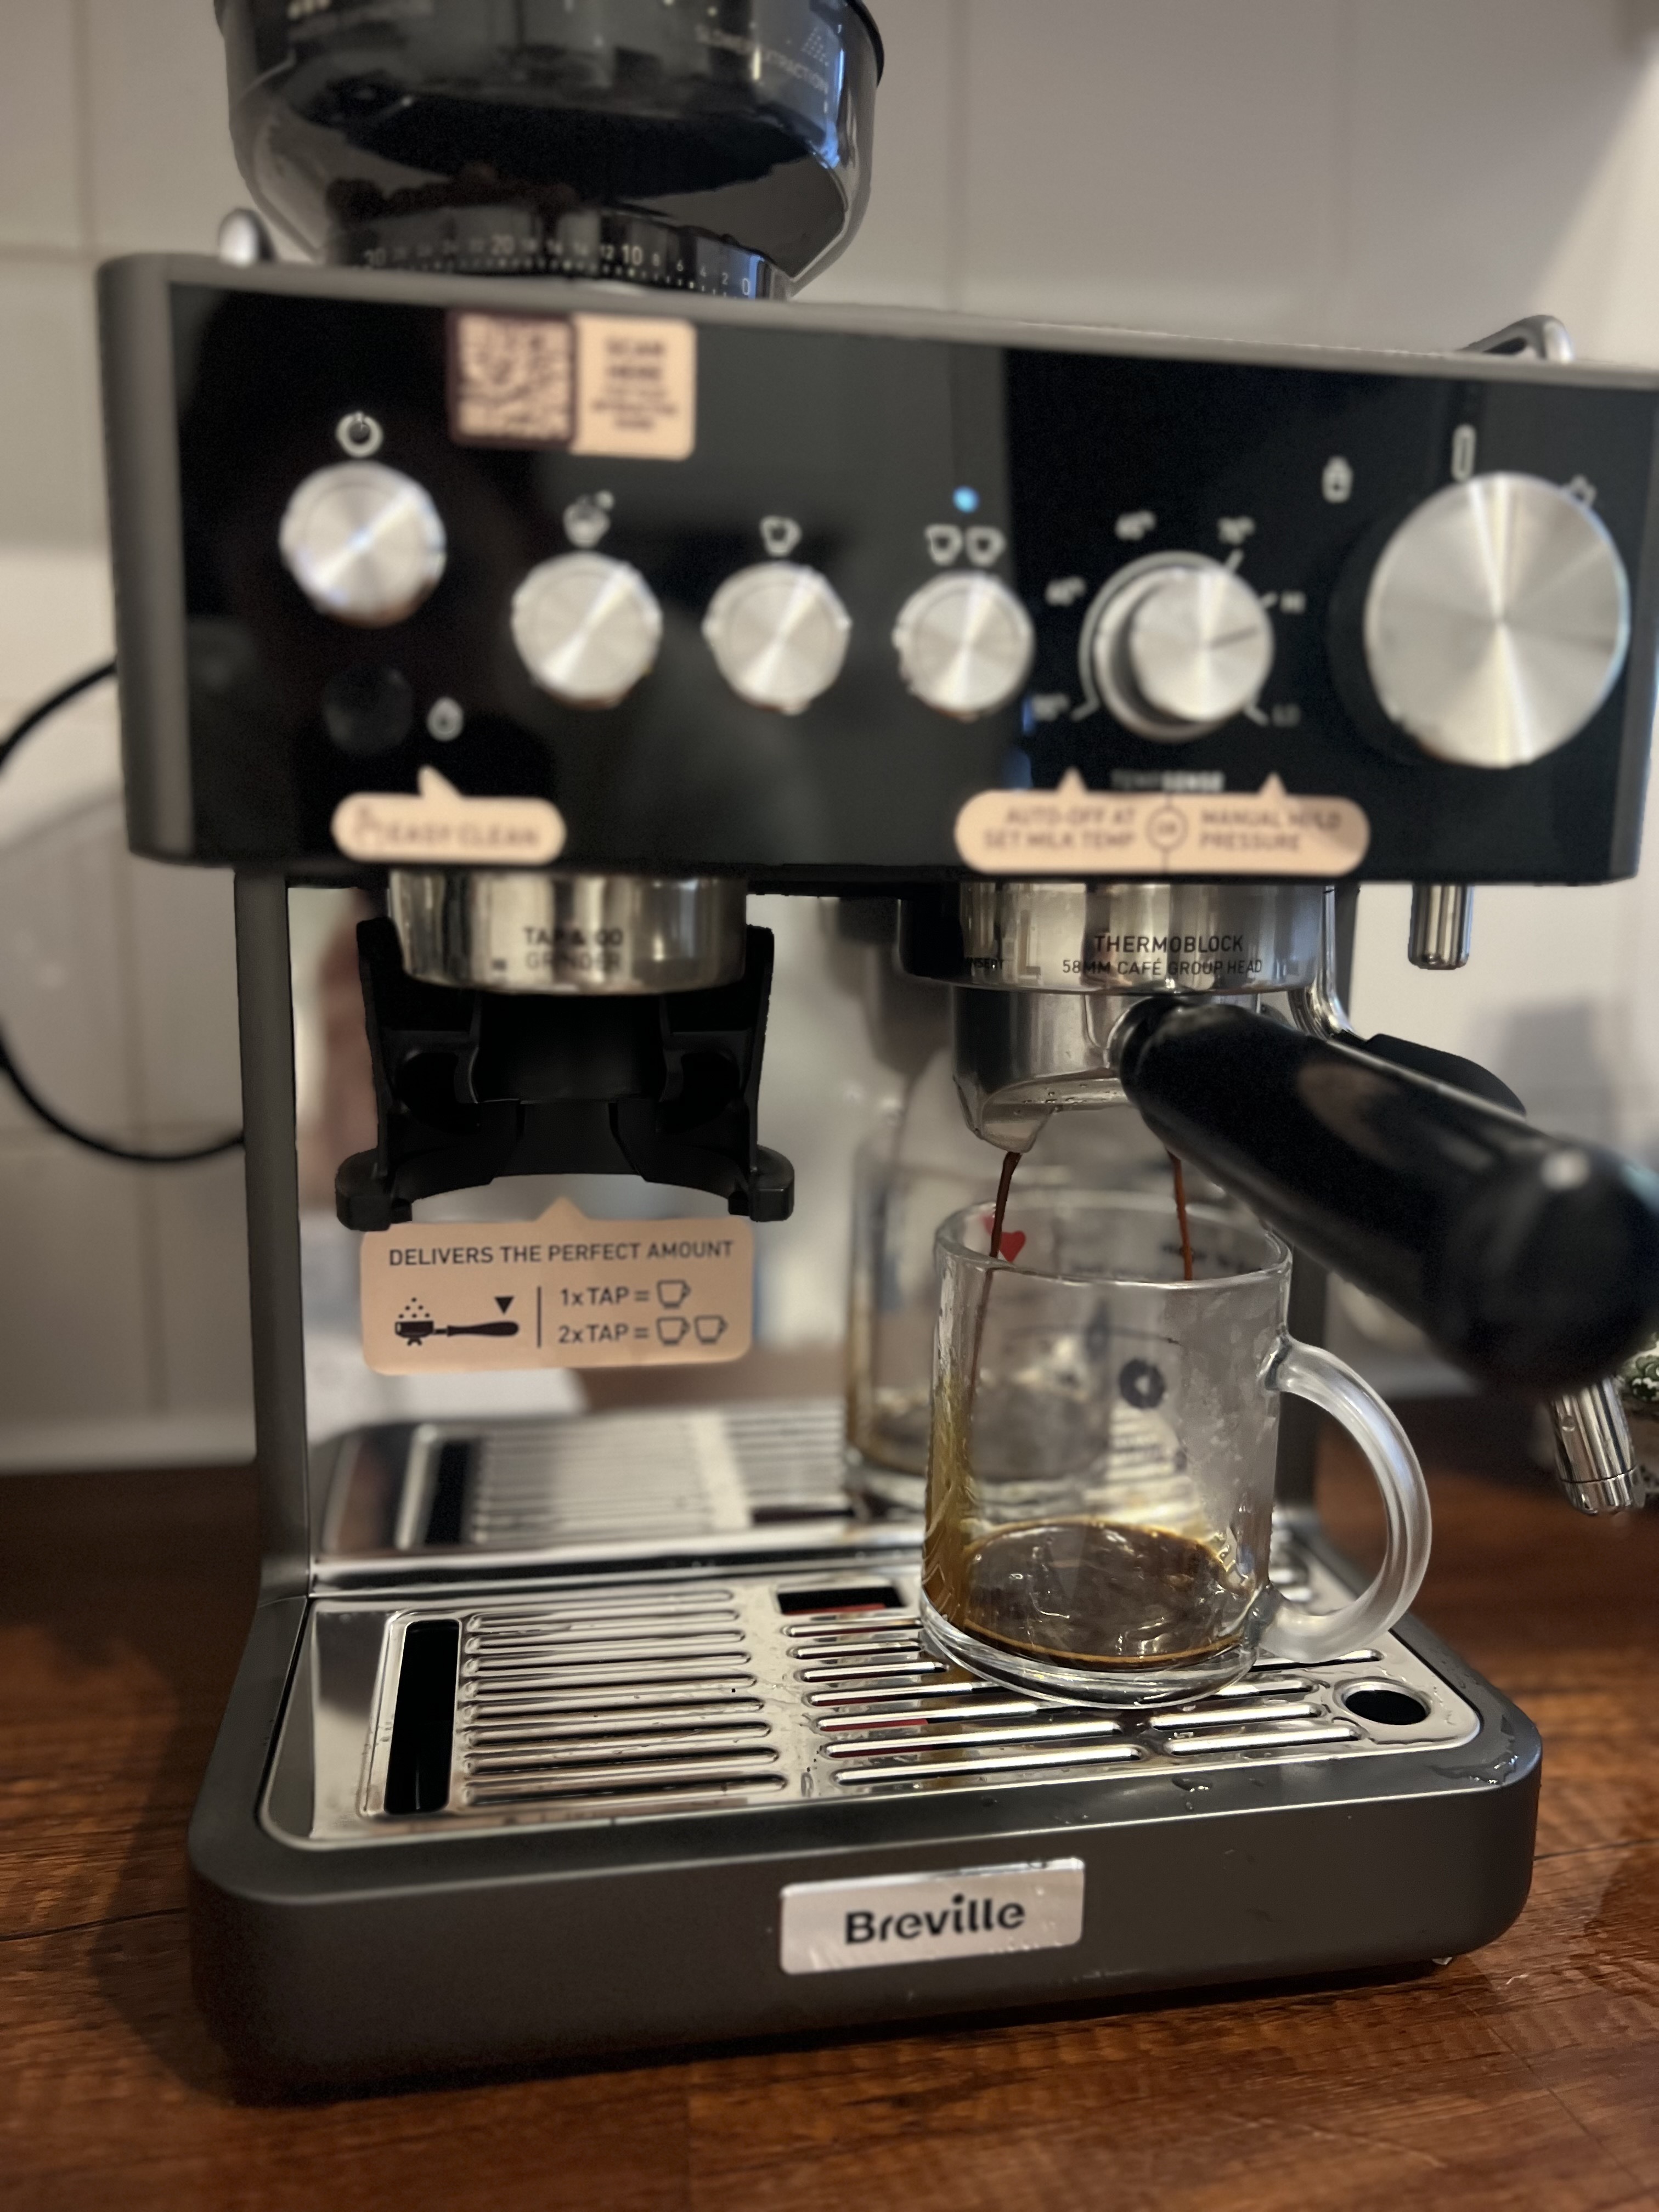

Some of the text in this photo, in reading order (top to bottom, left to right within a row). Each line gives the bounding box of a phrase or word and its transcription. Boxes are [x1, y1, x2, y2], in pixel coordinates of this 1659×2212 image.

[622, 244, 642, 266] 10
[721, 273, 729, 285] 2
[741, 278, 751, 296] 0
[1094, 934, 1243, 953] THERMOBLOCK
[1117, 958, 1163, 975] CAFÉ
[1167, 961, 1223, 975] GROUP
[1227, 959, 1262, 974] HEAD
[390, 1239, 733, 1266] DELIVERS THE PERFECT AMOUNT
[845, 1893, 1025, 1944] Breville
